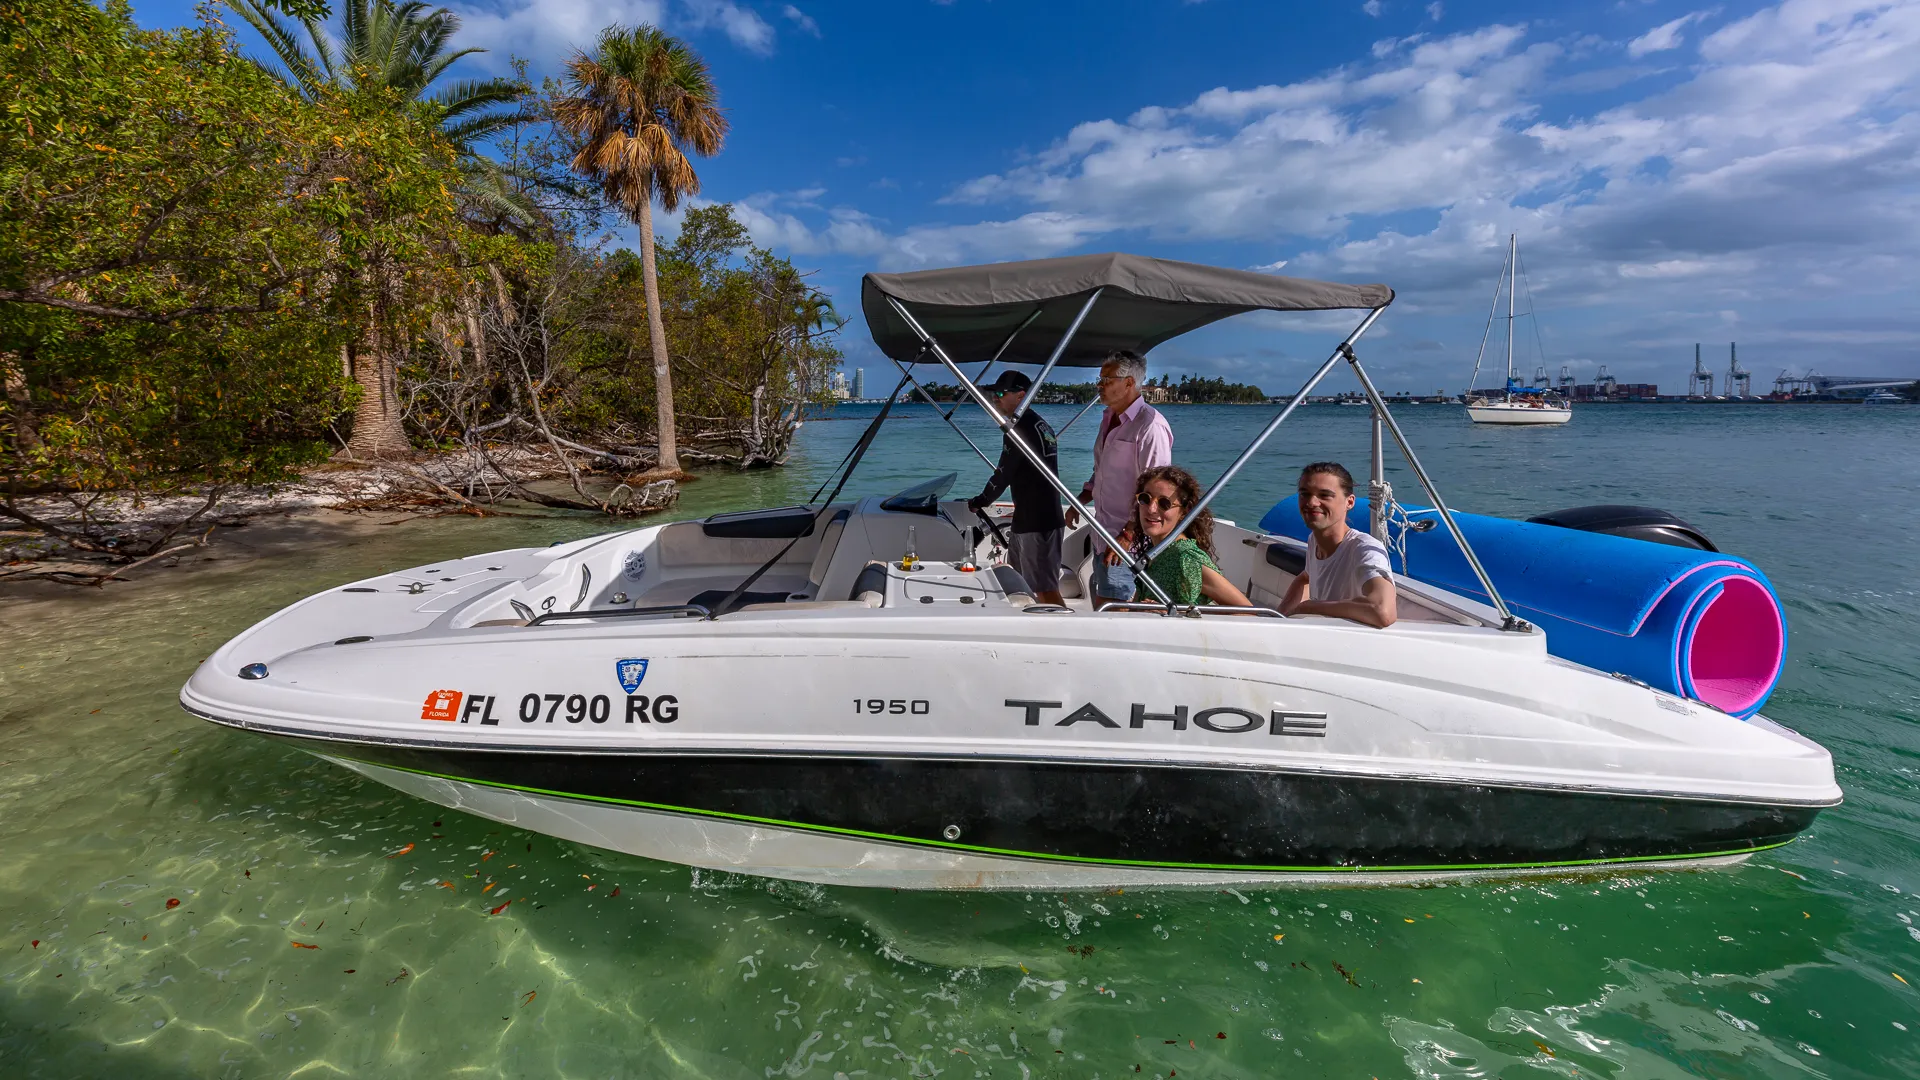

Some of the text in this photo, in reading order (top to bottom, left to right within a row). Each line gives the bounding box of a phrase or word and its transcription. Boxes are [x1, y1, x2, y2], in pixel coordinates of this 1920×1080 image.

[461, 693, 679, 726] FL 0790 RG
[853, 698, 930, 715] 1950
[1004, 699, 1327, 738] TAHOE
